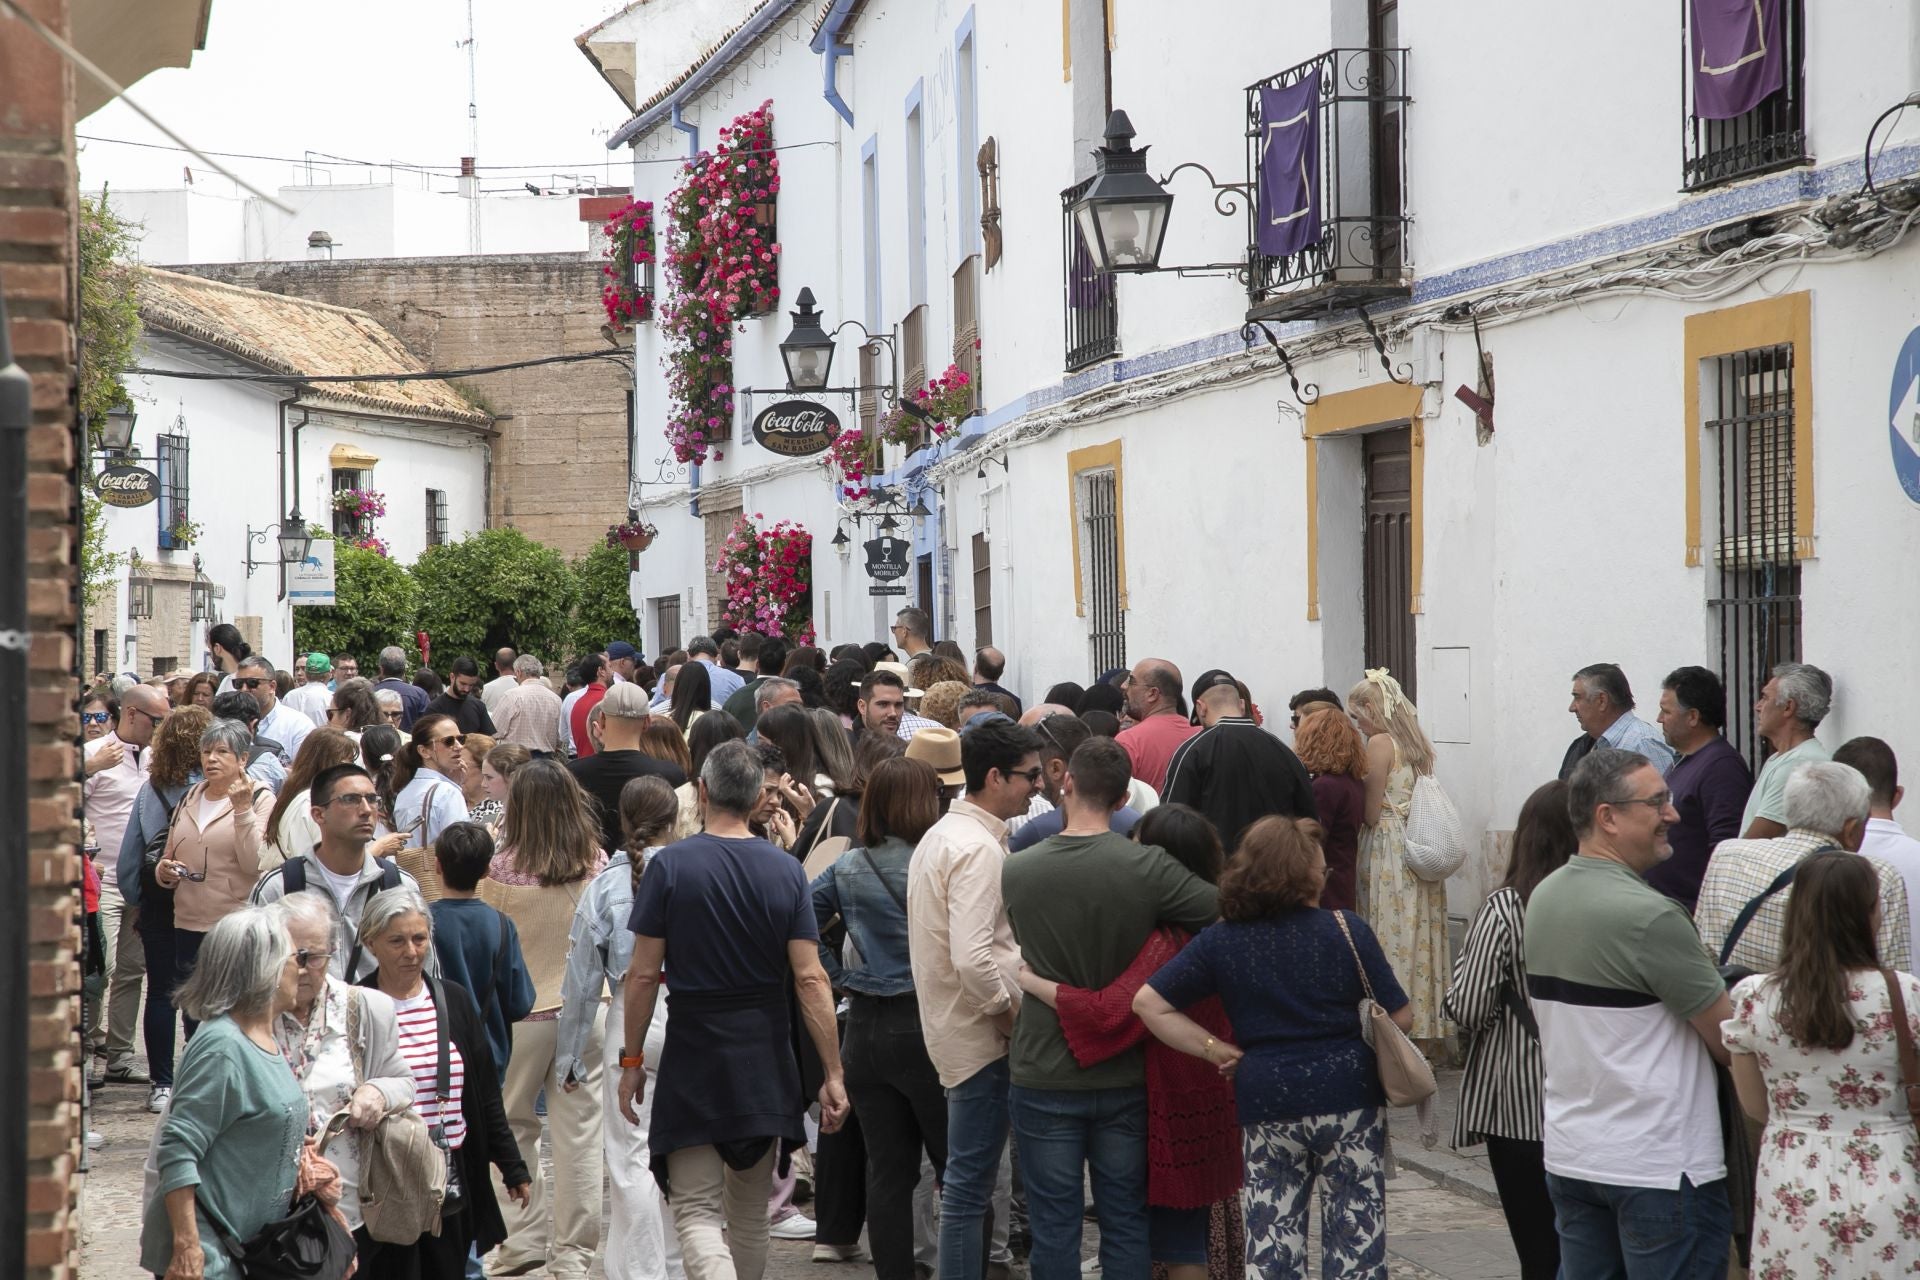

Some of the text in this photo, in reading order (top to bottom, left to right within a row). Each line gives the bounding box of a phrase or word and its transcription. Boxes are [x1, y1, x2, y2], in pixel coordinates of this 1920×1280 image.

[761, 411, 826, 433] Coca-Cola
[772, 440, 826, 452] SAN BASILIO
[98, 473, 150, 490] Coca-Cola
[118, 491, 147, 500] CABALLO
